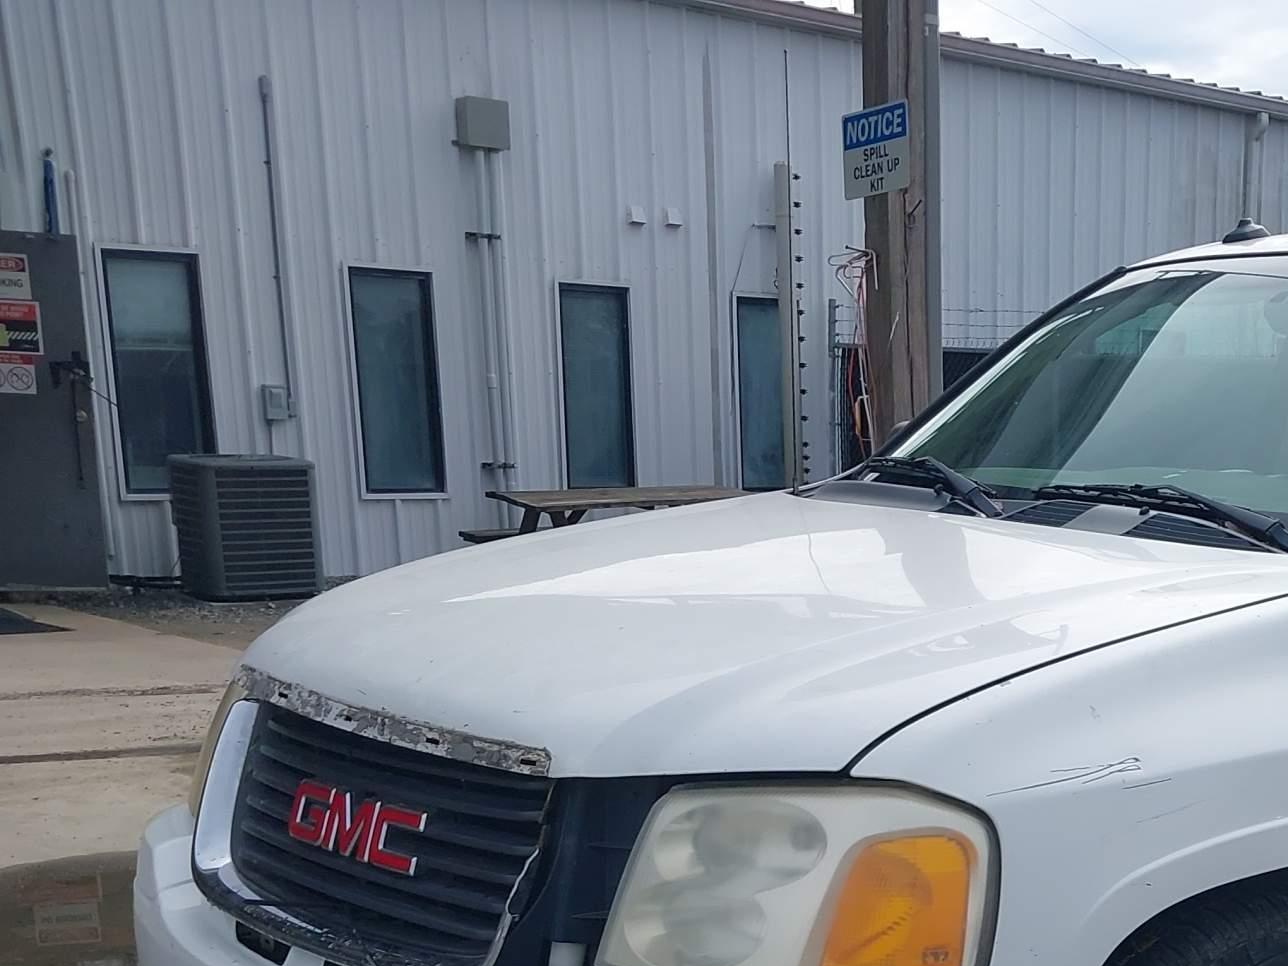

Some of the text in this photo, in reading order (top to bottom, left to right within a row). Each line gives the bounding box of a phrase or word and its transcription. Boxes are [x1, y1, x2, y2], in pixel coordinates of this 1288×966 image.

[846, 108, 904, 145] NOTICE
[863, 144, 889, 162] SPILL
[853, 157, 900, 180] CLEAN UP
[870, 177, 884, 192] KIT
[288, 779, 427, 876] GMC
